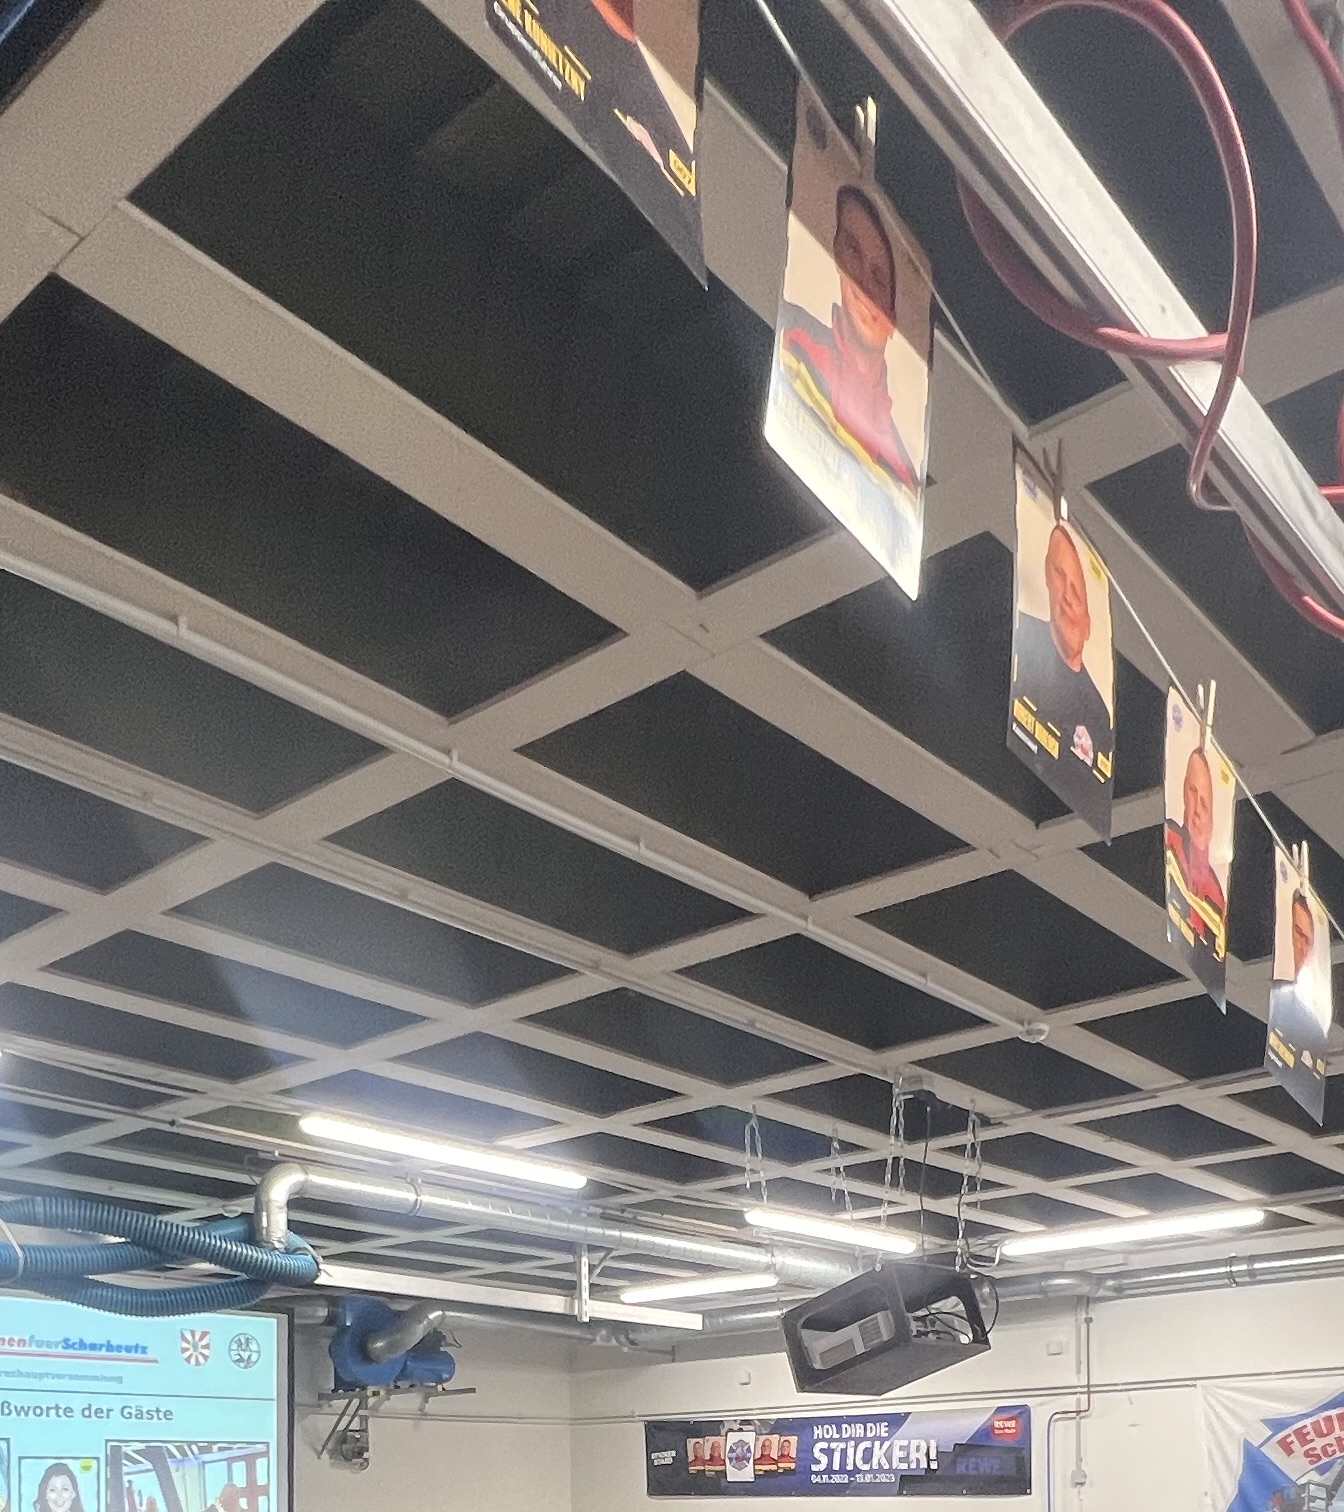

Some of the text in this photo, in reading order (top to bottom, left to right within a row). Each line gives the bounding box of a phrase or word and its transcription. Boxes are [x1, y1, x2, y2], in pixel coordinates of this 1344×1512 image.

[80, 1401, 114, 1420] der
[119, 1404, 174, 1422] Gäste
[813, 1421, 889, 1440] HOL DIR DIE
[810, 1438, 938, 1472] STICKER!
